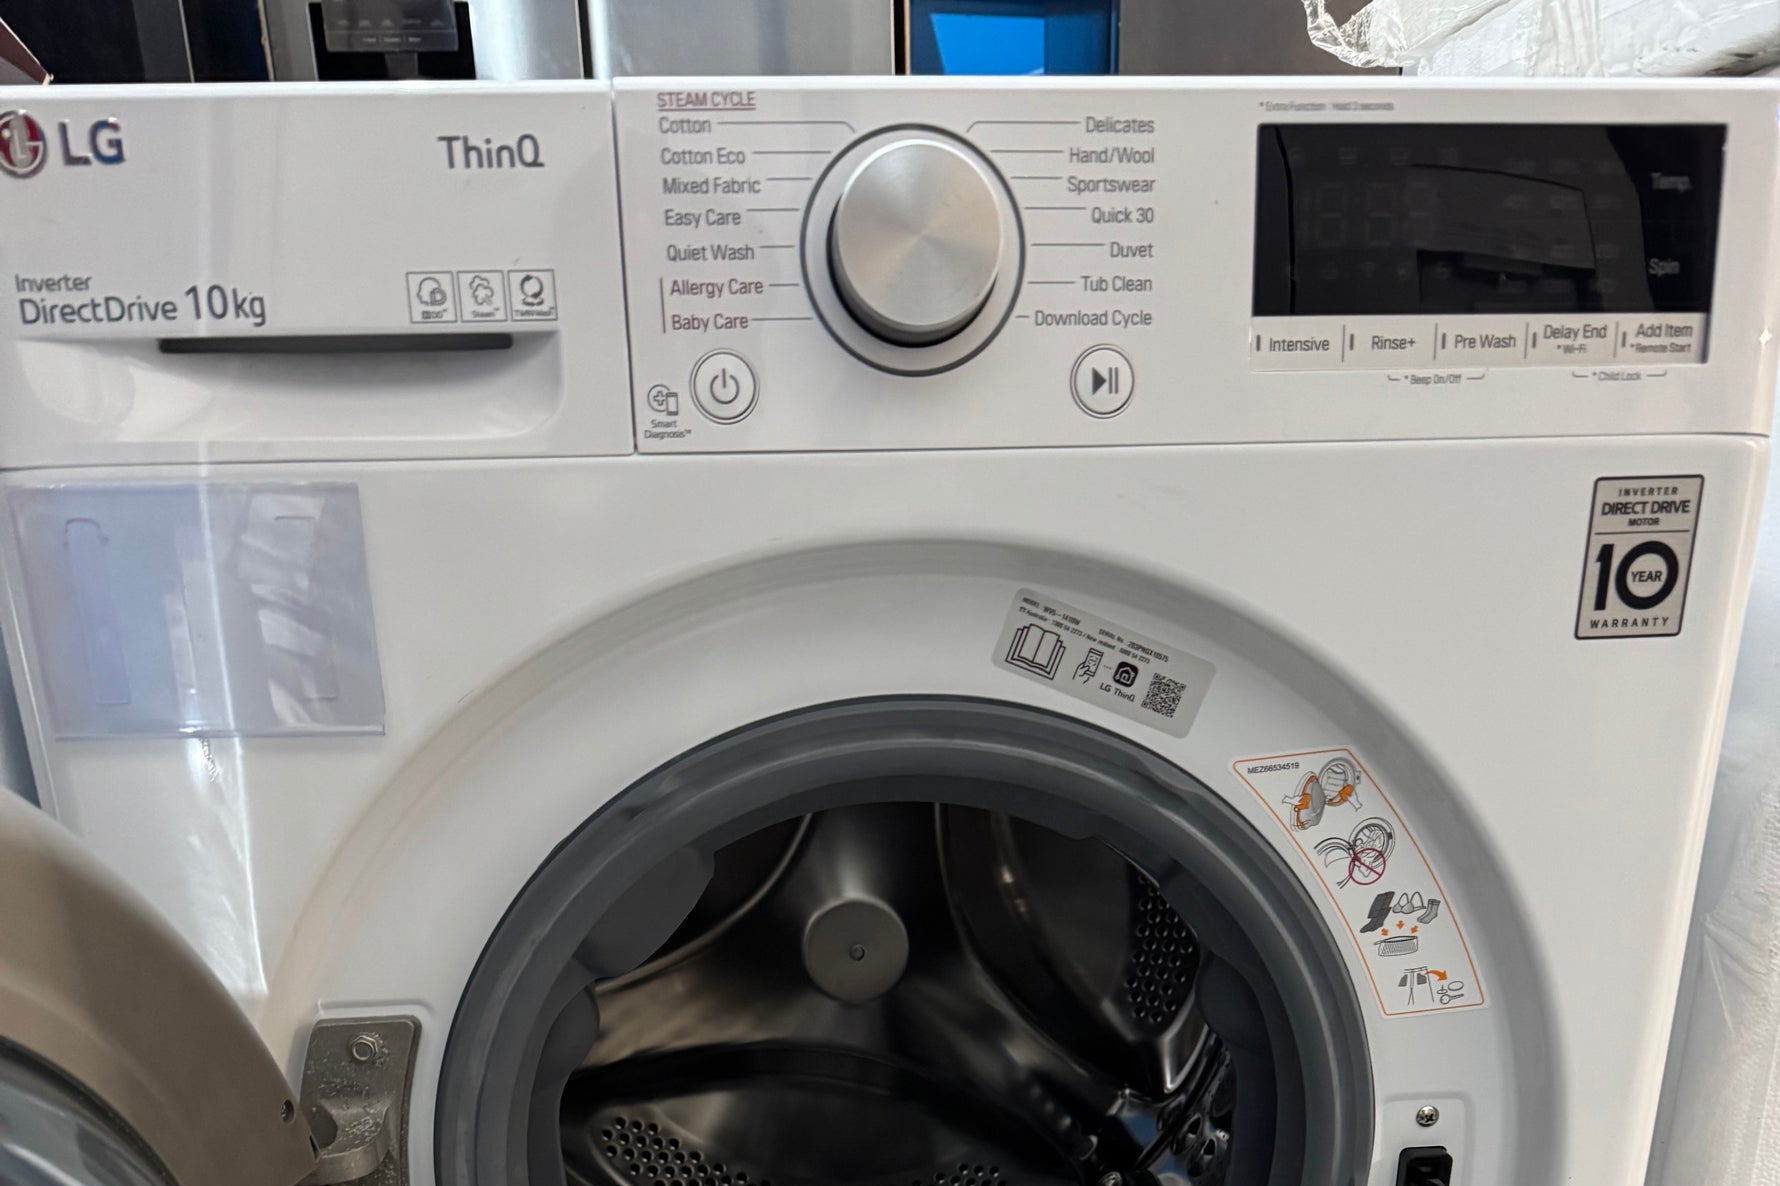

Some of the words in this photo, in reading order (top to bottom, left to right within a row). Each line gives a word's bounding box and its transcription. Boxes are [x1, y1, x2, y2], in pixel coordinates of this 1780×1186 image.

[657, 91, 708, 107] STEAM
[710, 90, 757, 106] CYCLE
[659, 116, 712, 134] Cotton
[1085, 115, 1155, 133] Delicates
[57, 116, 126, 167] LG
[436, 133, 545, 169] ThinQ
[660, 146, 713, 165] Cotton
[716, 146, 746, 165] Eco
[1068, 146, 1155, 164] Hand/Wool
[661, 176, 709, 194] Mixed
[713, 176, 762, 194] Fabric
[1066, 175, 1156, 195] Sportswear
[664, 207, 702, 229] Easy
[705, 207, 742, 226] Care
[1090, 206, 1133, 224] Quick
[1135, 206, 1155, 224] 30
[666, 243, 708, 262] Quiet
[710, 243, 755, 261] Wash
[1109, 240, 1155, 258] Duvet
[1648, 257, 1680, 277] Spin
[14, 273, 93, 293] Inverter
[670, 278, 725, 299] Allergy
[728, 277, 764, 295] Care
[1080, 274, 1109, 292] Tub
[1112, 274, 1153, 292] Clean
[19, 294, 178, 325] DirectDrive
[1033, 308, 1109, 326] Download
[1112, 308, 1153, 329] Cycle
[671, 313, 710, 334] Baby
[713, 312, 749, 330] Care
[1543, 323, 1580, 341] Delay
[1583, 322, 1609, 339] End
[1635, 322, 1662, 338] Add
[1665, 322, 1694, 338] Item
[1269, 335, 1331, 352] Intensive
[1371, 333, 1416, 350] Rinse+
[1454, 332, 1477, 349] Pre
[1480, 333, 1517, 349] Wash
[651, 418, 678, 429] Smart
[1618, 486, 1679, 497] INVERTER
[1601, 500, 1650, 516] DIRECT
[1650, 499, 1692, 514] DRIVE
[1627, 517, 1660, 527] MOTOR
[1593, 540, 1680, 611] 10
[1630, 570, 1663, 583] YEAR
[1589, 616, 1670, 629] WARRANTY
[1100, 682, 1112, 693] LG
[1114, 687, 1136, 703] ThinQ
